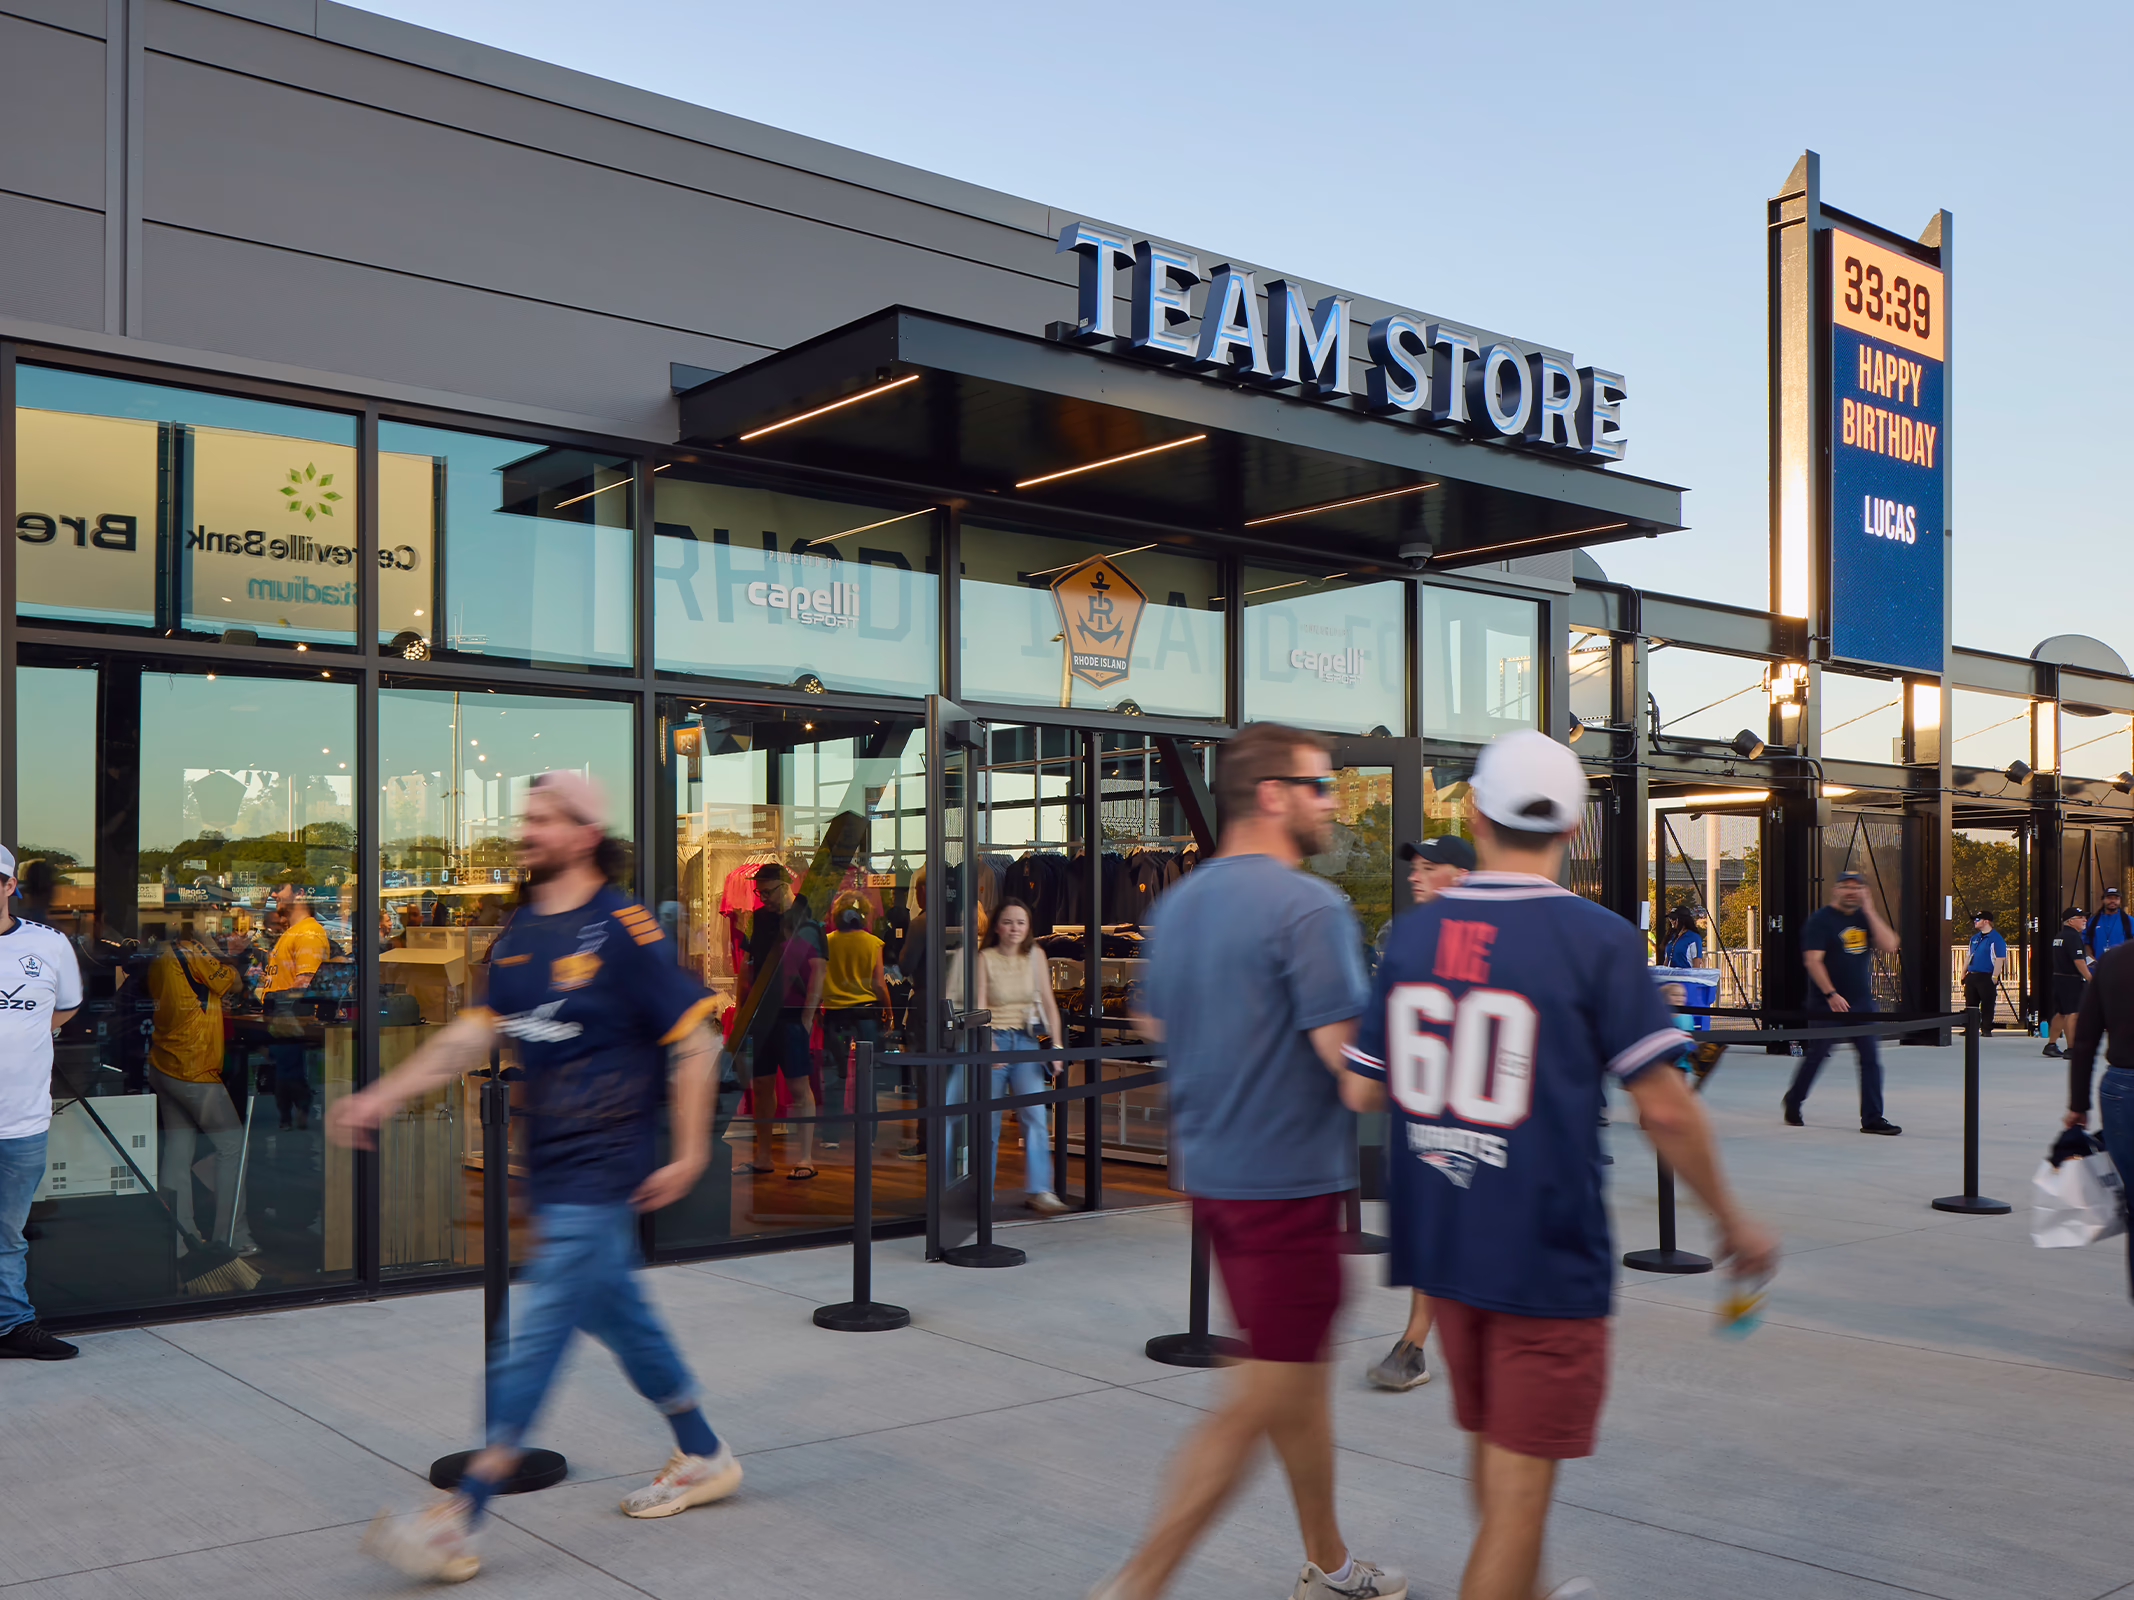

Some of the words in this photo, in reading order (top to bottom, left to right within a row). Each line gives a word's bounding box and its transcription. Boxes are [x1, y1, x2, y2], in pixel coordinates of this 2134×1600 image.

[1844, 256, 1931, 340] 33:39
[1056, 222, 1354, 395] TEAM
[1366, 313, 1627, 460] STORE
[1859, 344, 1923, 407] HAPPY
[1843, 397, 1937, 468] BIRTHDAY
[1864, 495, 1917, 545] LUCAS
[747, 581, 860, 619] capelli
[801, 612, 860, 629] SPORT
[1073, 655, 1099, 667] RHODE
[1100, 660, 1127, 670] ISLAND
[1290, 647, 1364, 679] capelli
[1386, 981, 1541, 1129] 60
